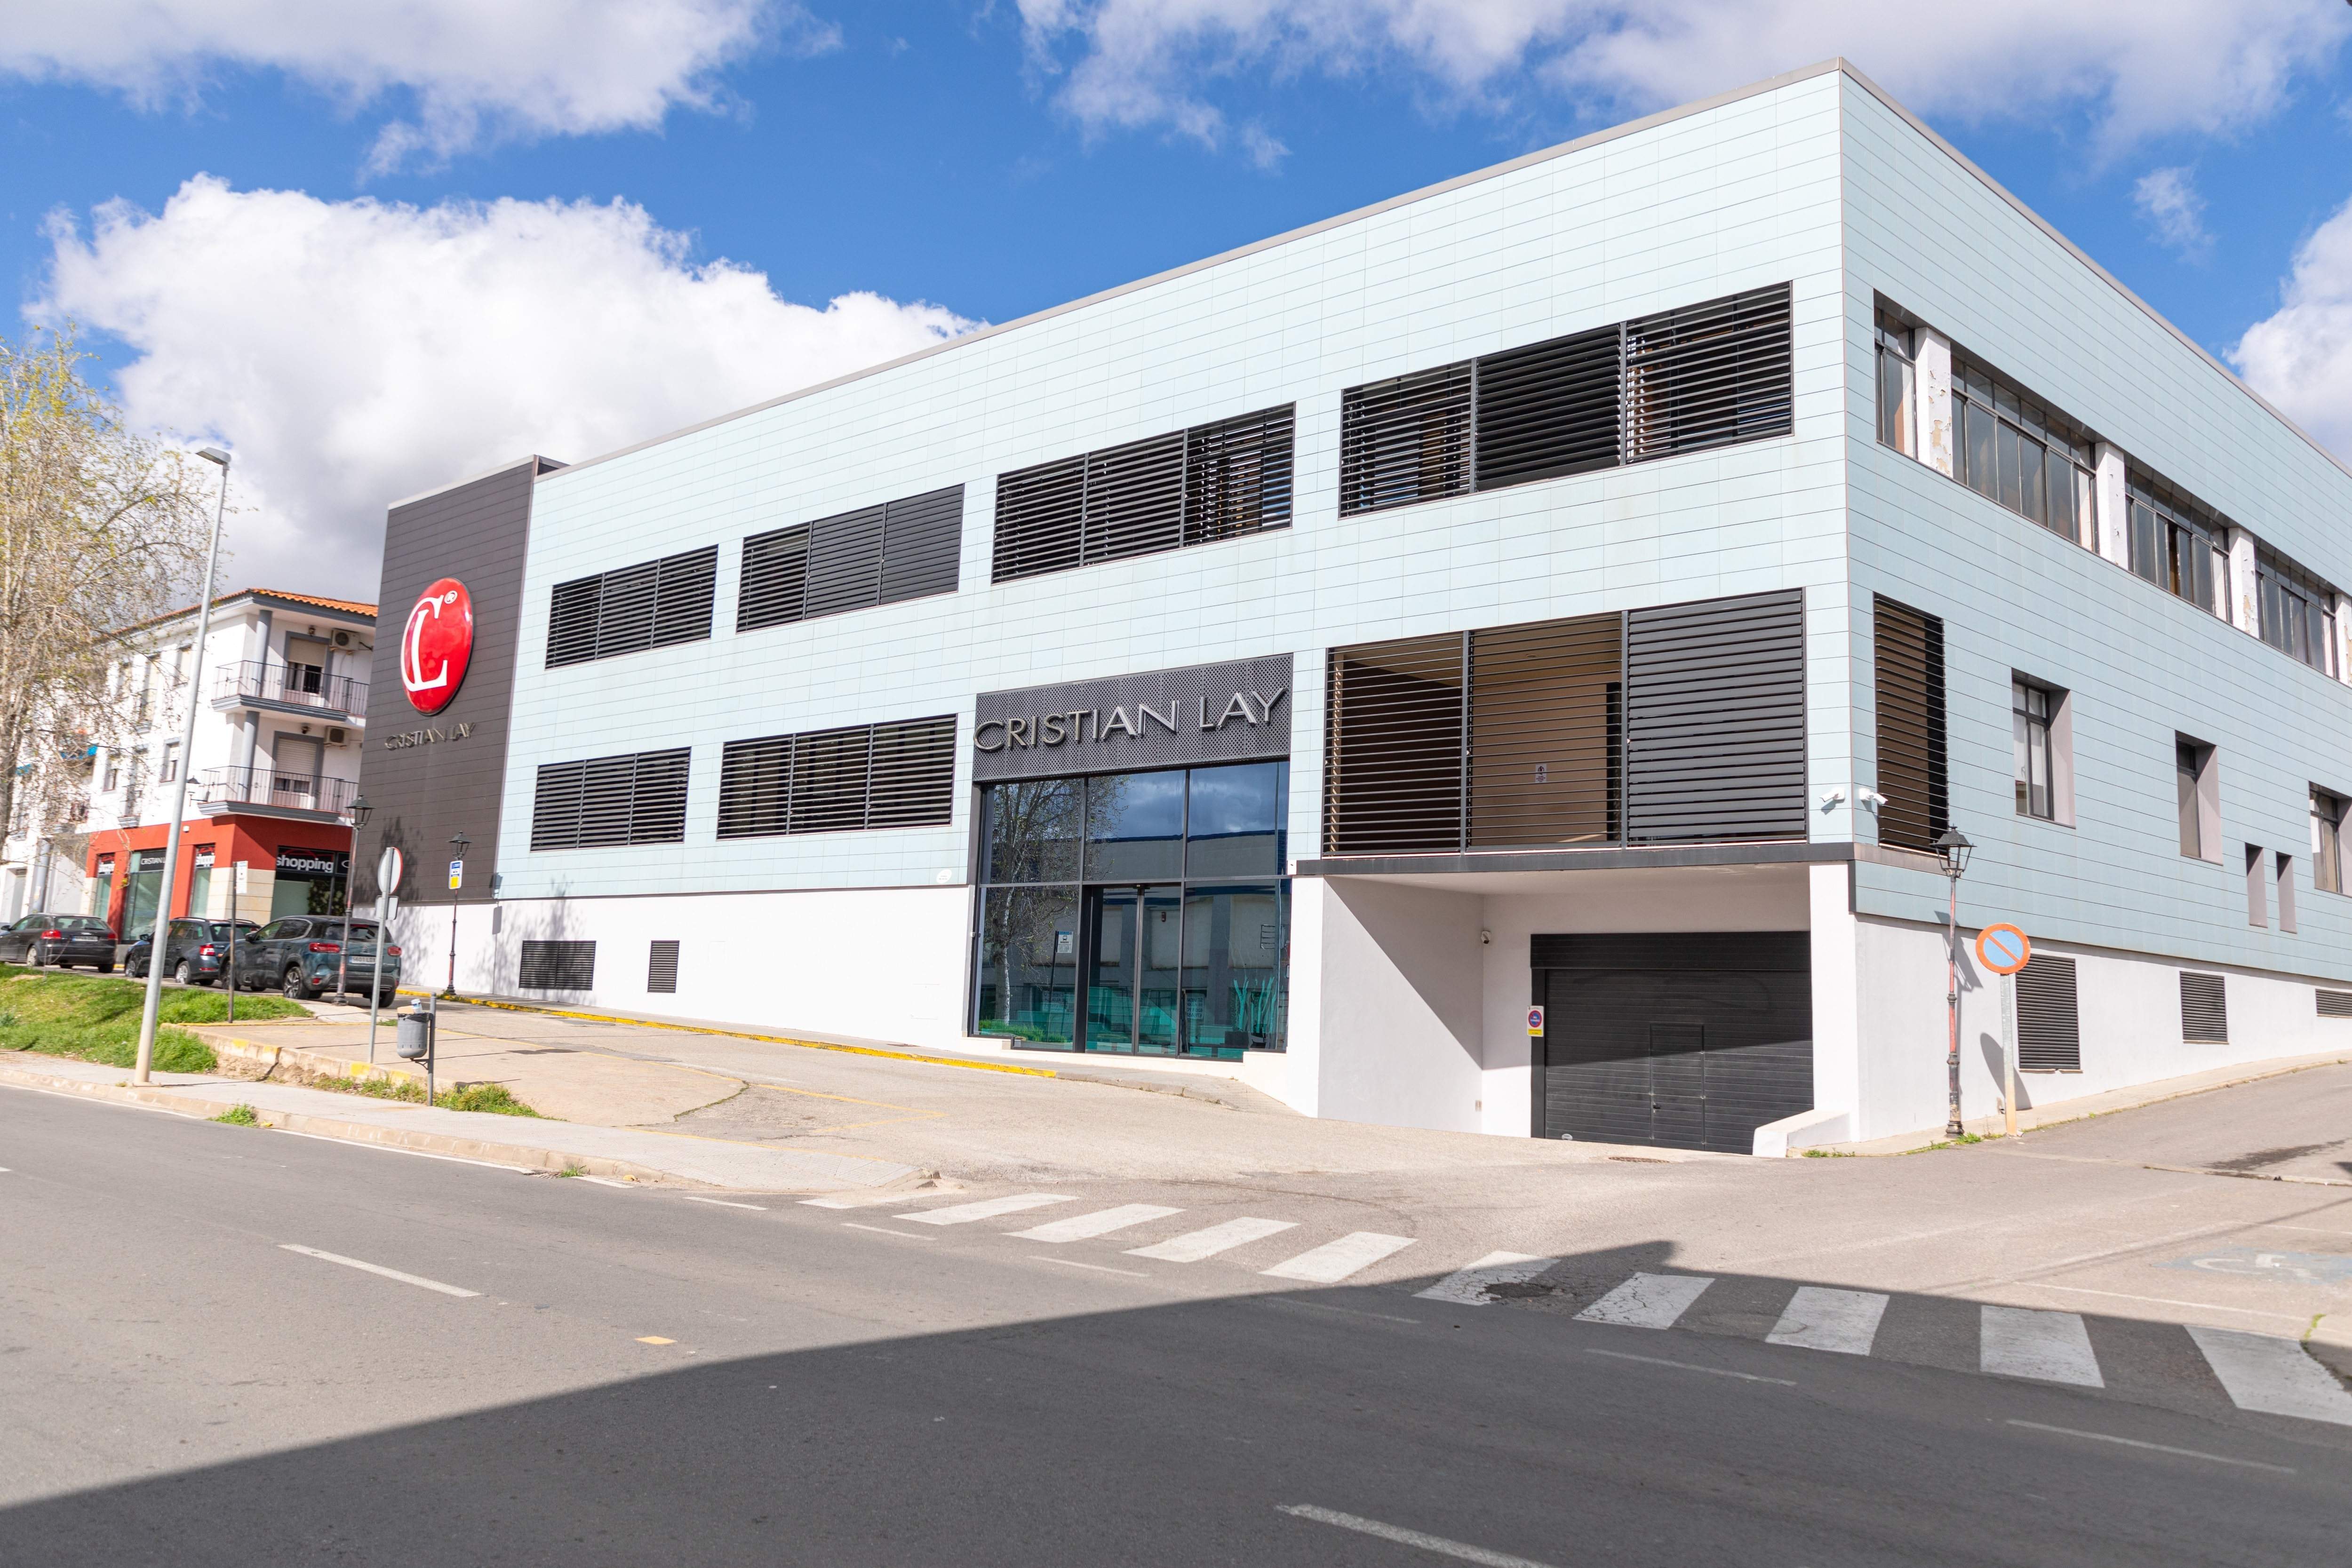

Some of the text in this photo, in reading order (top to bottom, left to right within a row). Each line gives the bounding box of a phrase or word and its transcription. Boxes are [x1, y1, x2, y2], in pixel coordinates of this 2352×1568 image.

[973, 687, 1288, 751] CRISTIAN LAY
[385, 722, 476, 750] CRISTIAN LAY
[277, 854, 334, 873] shopping
